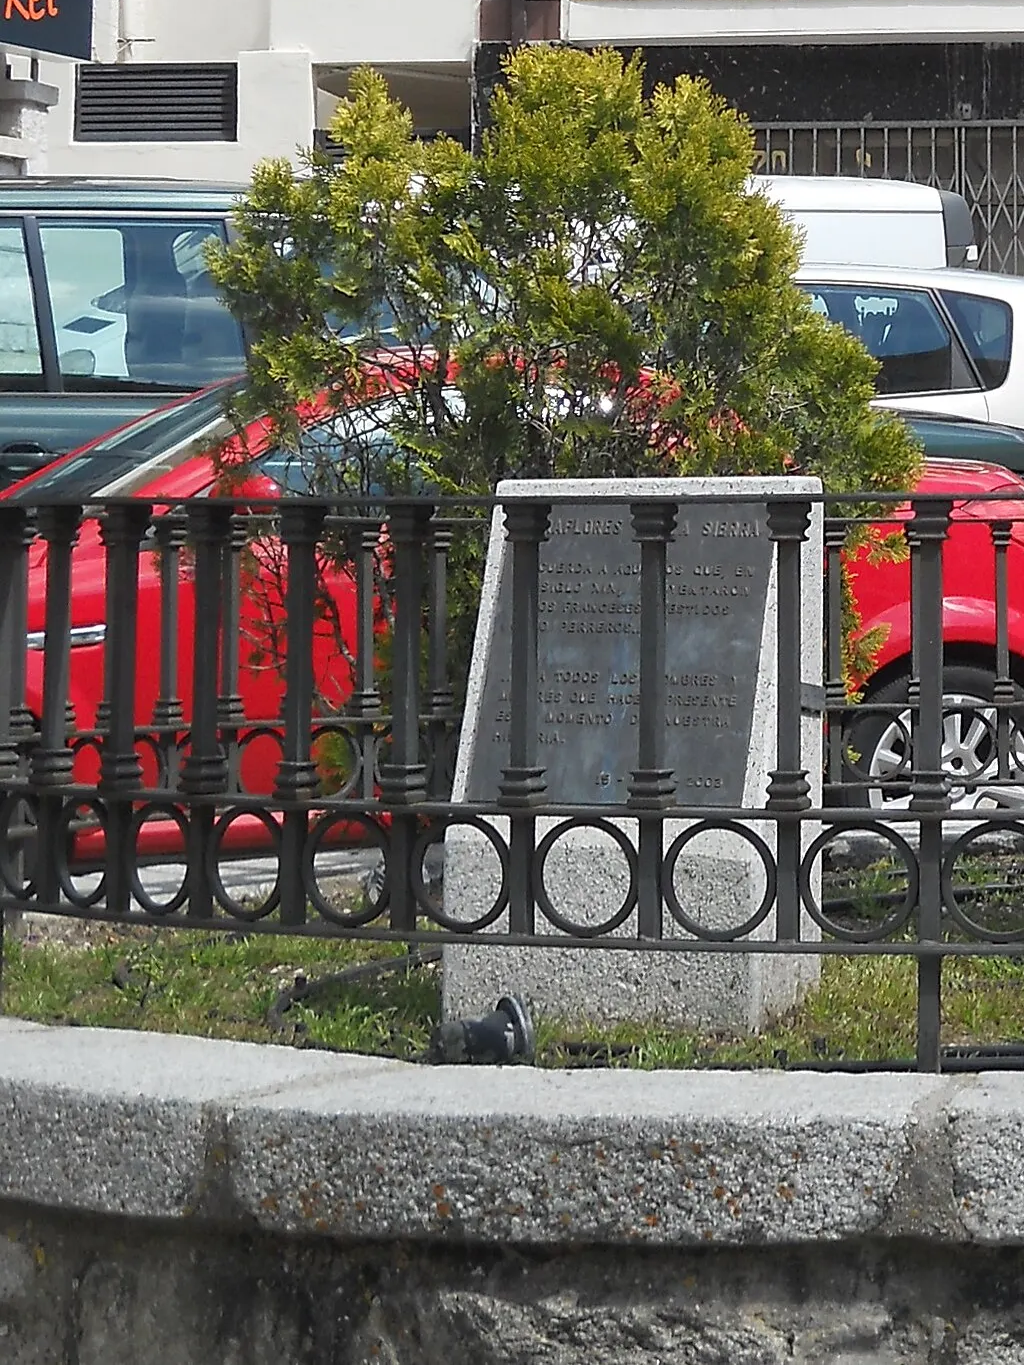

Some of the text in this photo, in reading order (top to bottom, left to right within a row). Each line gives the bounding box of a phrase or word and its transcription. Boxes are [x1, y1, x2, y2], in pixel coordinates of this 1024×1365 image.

[701, 520, 760, 537] SIERRA
[552, 670, 599, 686] TODOS
[568, 690, 598, 704] QUE
